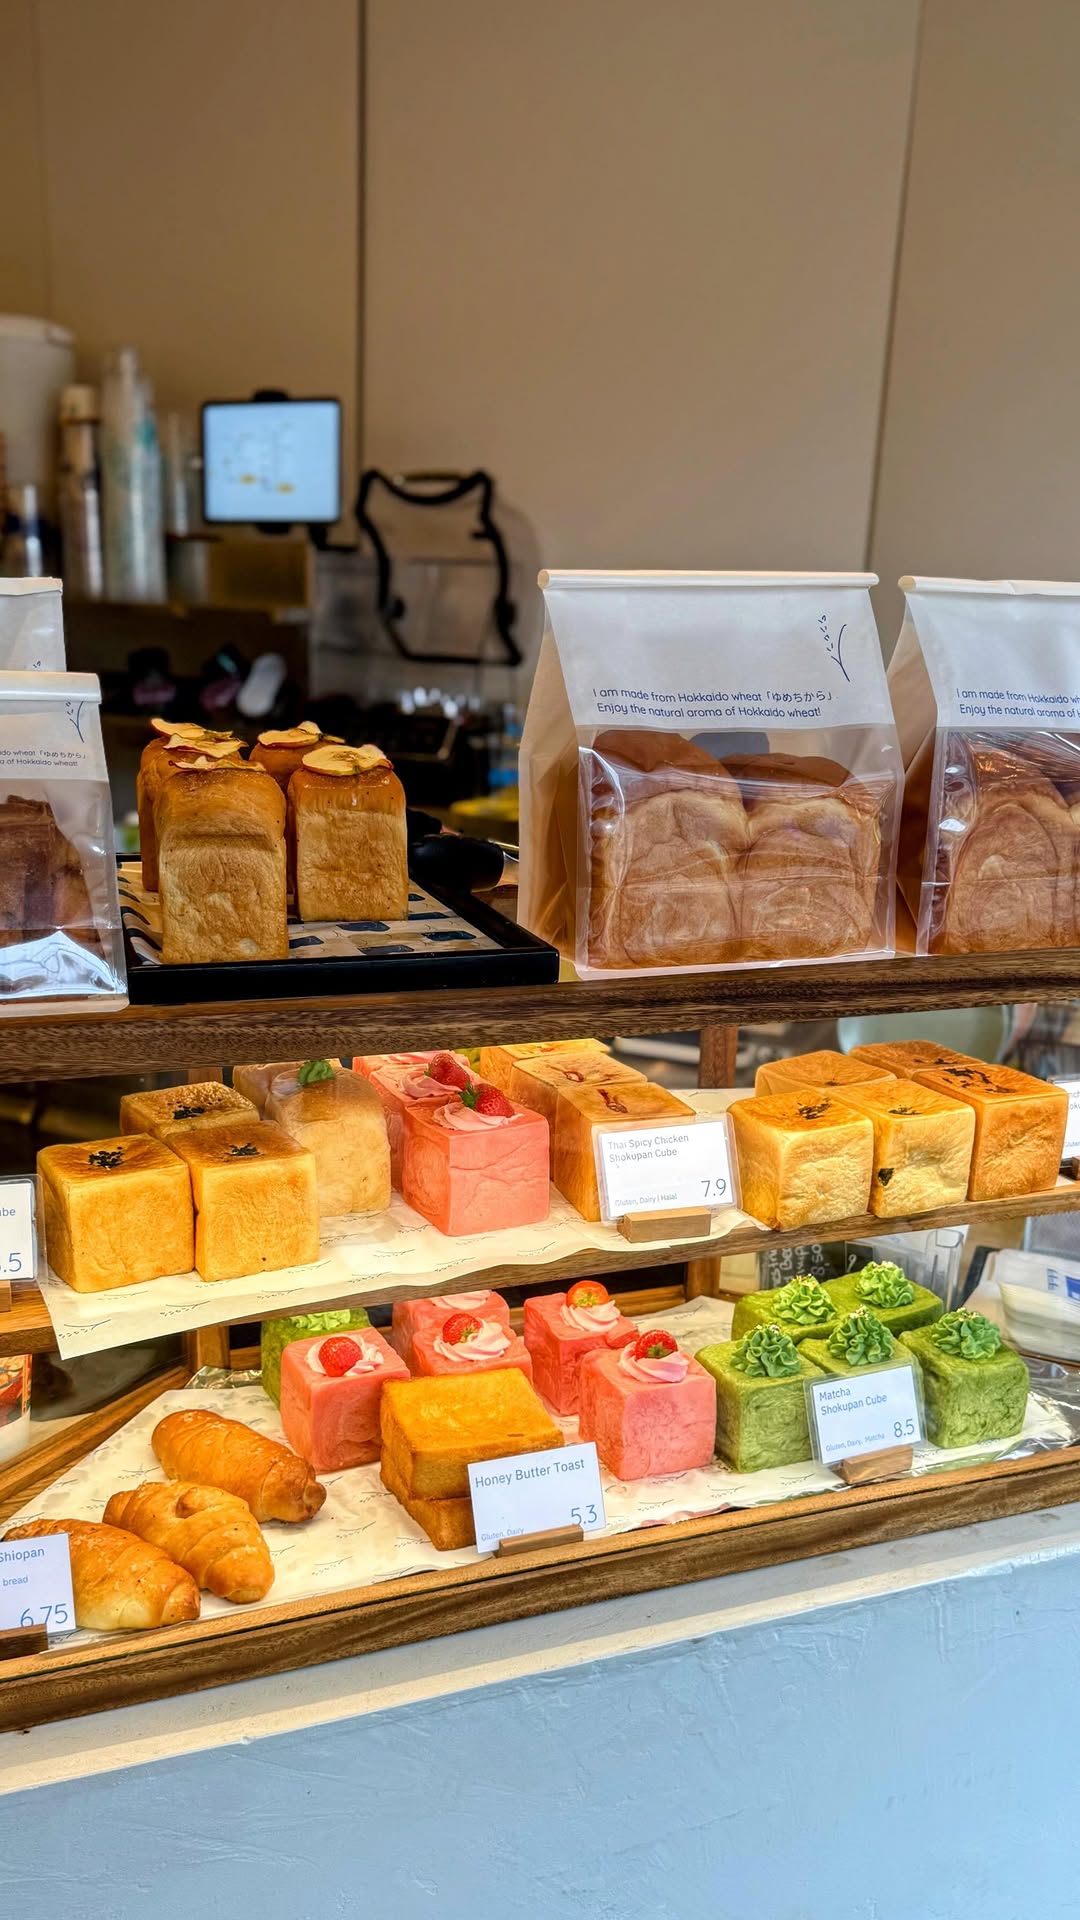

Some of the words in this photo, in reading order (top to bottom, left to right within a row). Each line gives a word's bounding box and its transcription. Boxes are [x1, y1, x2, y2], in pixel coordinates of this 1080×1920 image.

[592, 688, 597, 697] I
[599, 689, 618, 697] am
[621, 689, 649, 700] made
[651, 691, 676, 702] from
[678, 691, 729, 702] Hokkaido
[731, 691, 762, 701] wheat
[956, 688, 960, 698] I
[961, 689, 979, 699] am
[979, 690, 1005, 700] made
[1006, 691, 1027, 701] from
[1027, 693, 1069, 704] Hokkaido
[597, 703, 628, 715] Enjoy
[630, 704, 647, 714] the
[648, 707, 684, 718] natural
[686, 709, 722, 718] aroma
[725, 706, 736, 716] of
[738, 706, 785, 717] Hokkaido
[787, 707, 821, 717] wheat!
[959, 704, 986, 716] Enjoy
[988, 705, 1002, 715] the
[1004, 706, 1035, 716] natural
[1037, 709, 1066, 718] aroma
[1067, 708, 1076, 718] of
[608, 1141, 627, 1150] Thai
[628, 1138, 653, 1150] Spicy
[654, 1134, 689, 1146] Chicken
[609, 1150, 653, 1163] Shokupan
[655, 1147, 678, 1157] Cube
[701, 1178, 727, 1198] 7.9
[819, 1387, 851, 1401] Matcha
[821, 1399, 864, 1416] Shokupan
[865, 1394, 888, 1406] Cube
[893, 1418, 915, 1438] 8.5
[475, 1472, 512, 1488] Honey
[515, 1466, 551, 1481] Butter
[553, 1459, 585, 1473] Toast
[571, 1504, 598, 1526] 5.3
[2, 1576, 29, 1587] bread
